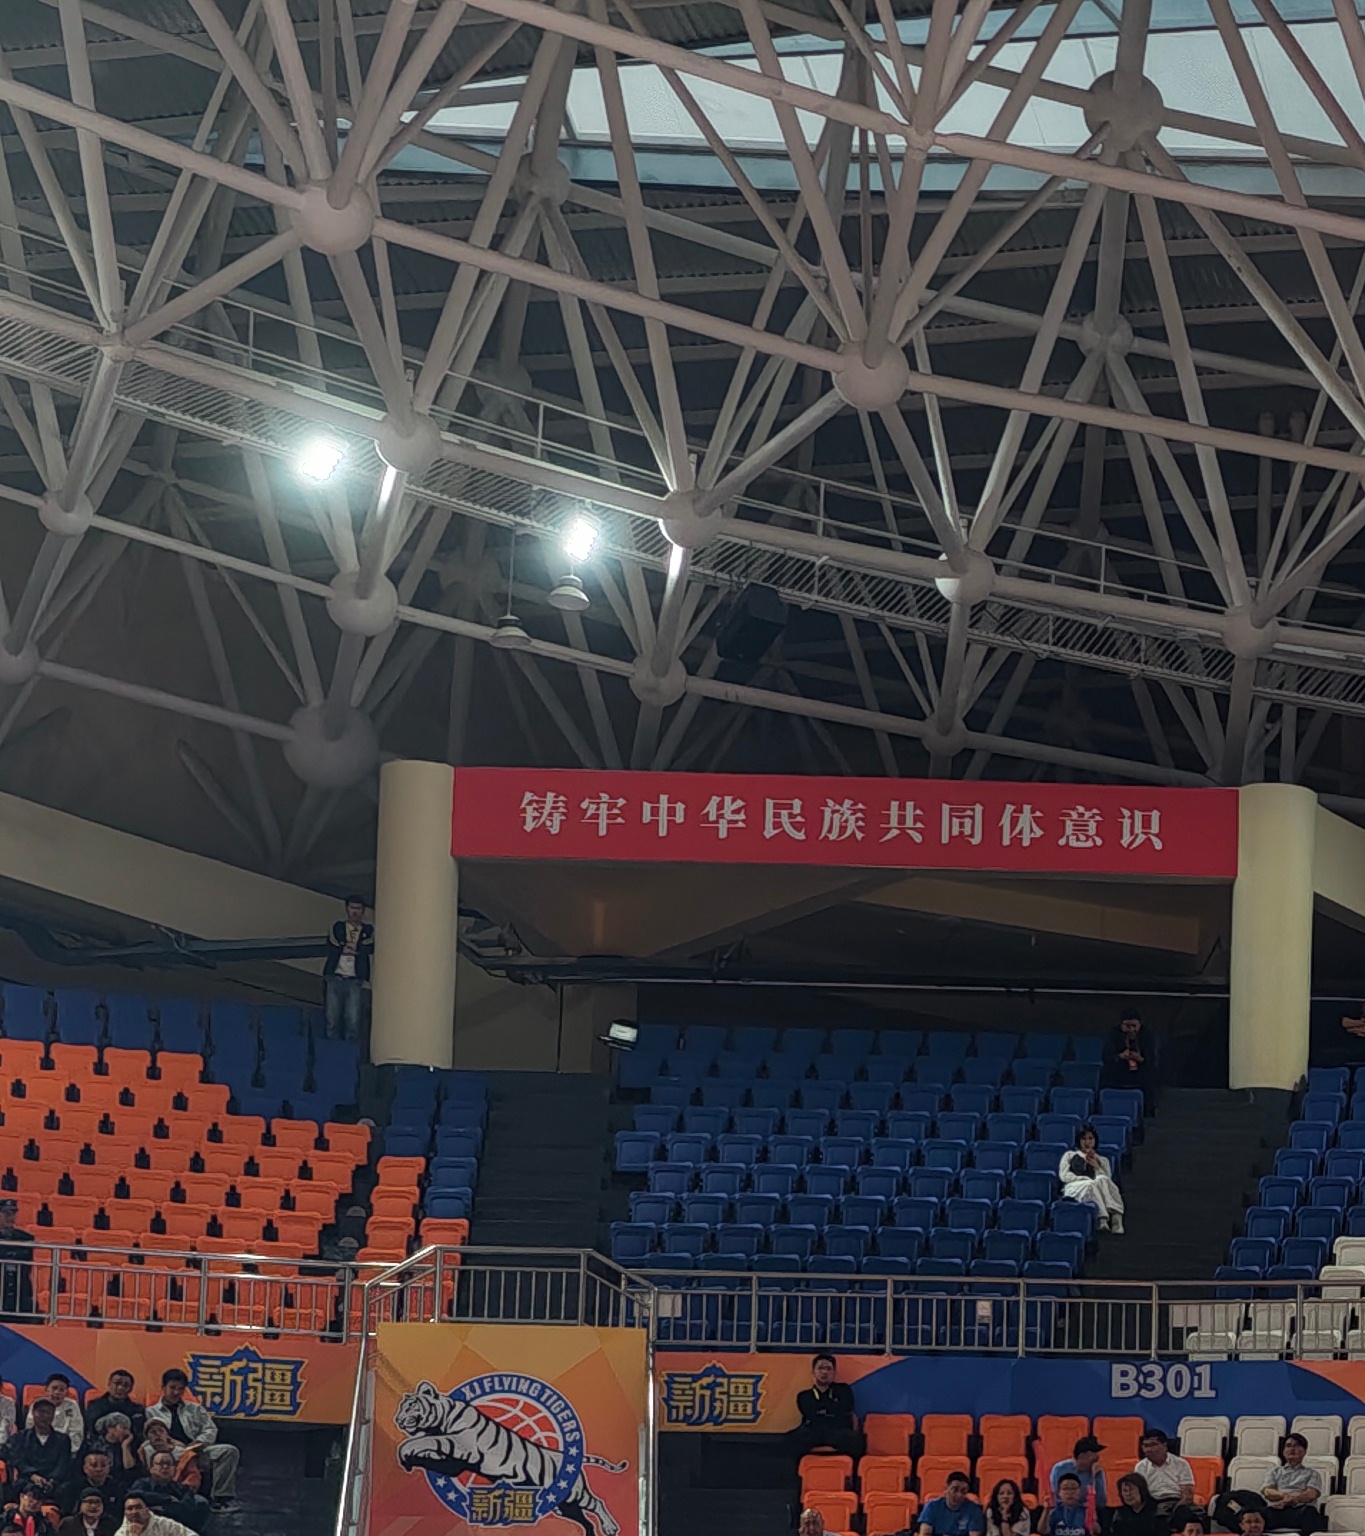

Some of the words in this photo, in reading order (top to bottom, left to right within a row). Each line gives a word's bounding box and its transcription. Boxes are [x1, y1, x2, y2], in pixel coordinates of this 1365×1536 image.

[518, 790, 1166, 853] 铸牢中华民族共同体意识
[194, 1356, 297, 1414] 新疆
[483, 1371, 538, 1398] FLYING
[532, 1379, 582, 1443] TIGERS
[669, 1373, 759, 1423] 新疆
[1109, 1361, 1218, 1399] B301
[468, 1487, 537, 1526] 新疆
